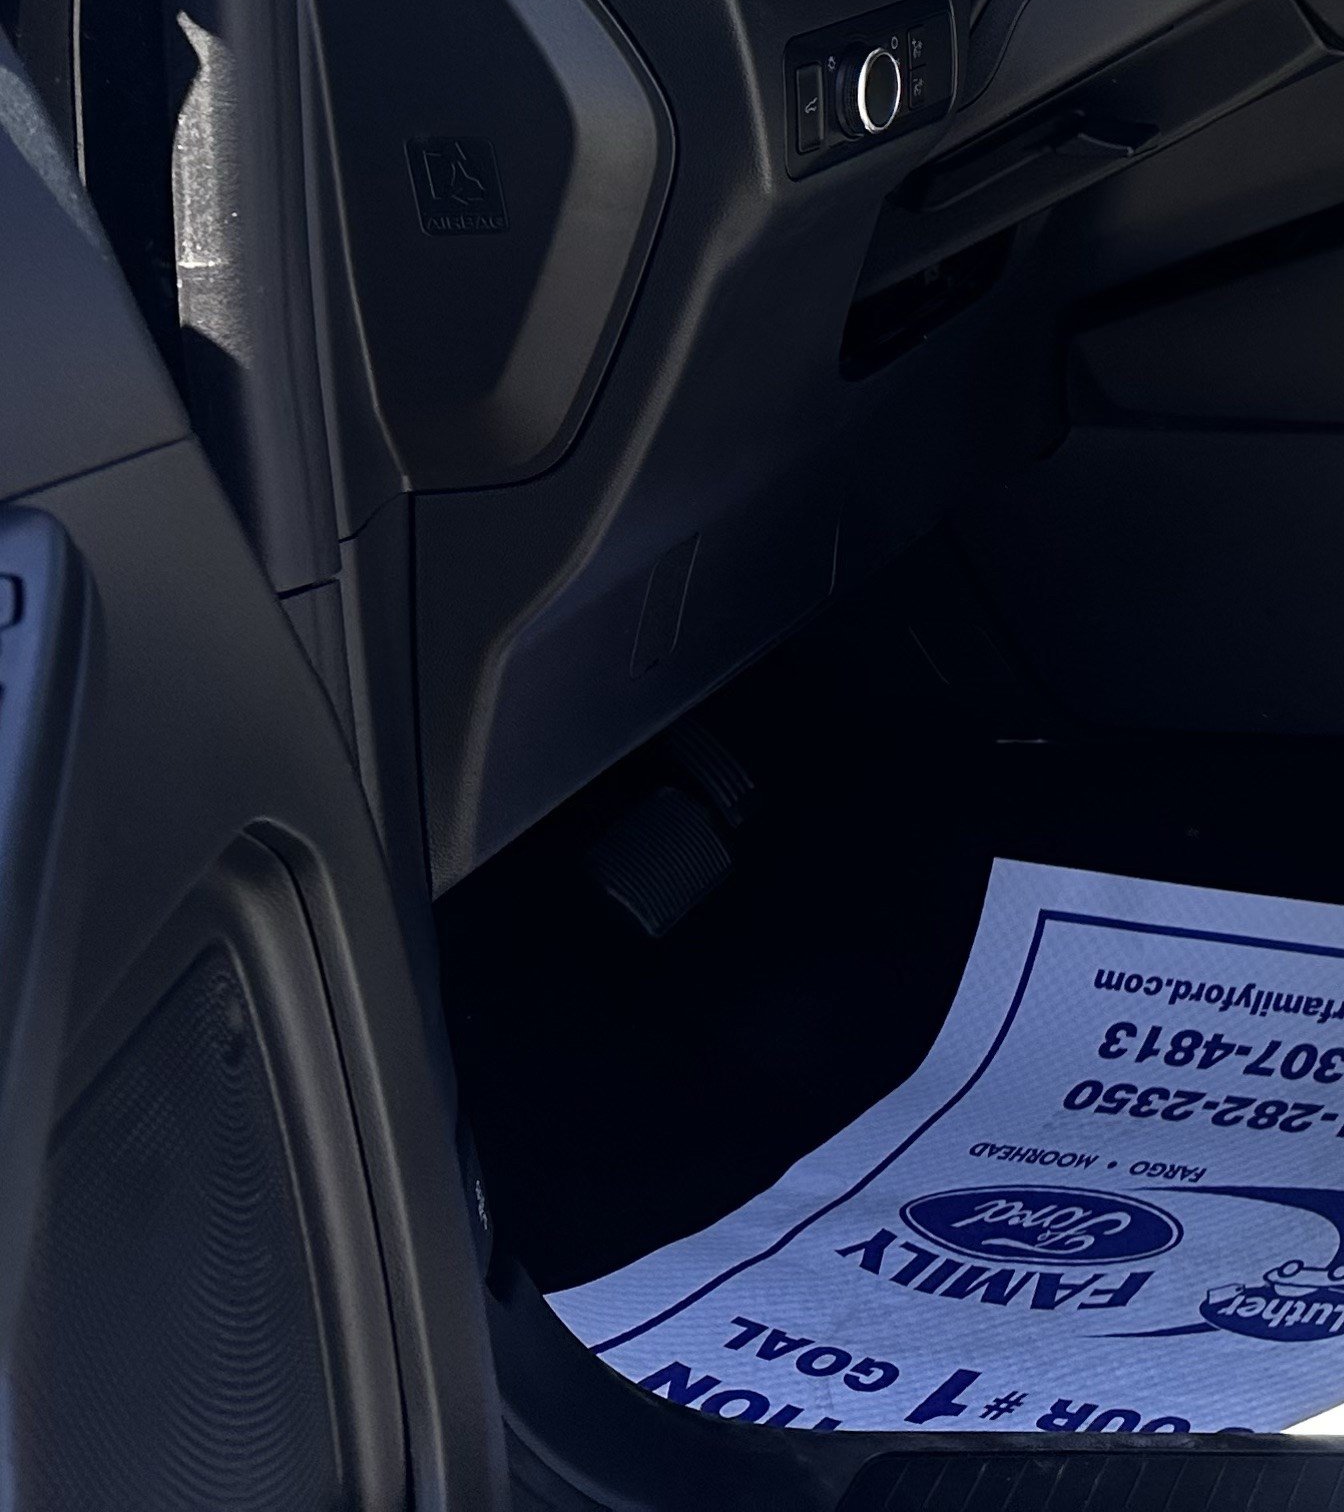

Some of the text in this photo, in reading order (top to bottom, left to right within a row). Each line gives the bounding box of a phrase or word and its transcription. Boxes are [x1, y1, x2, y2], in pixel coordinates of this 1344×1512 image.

[968, 1141, 1208, 1184] FARGO MOORHEAD
[951, 1198, 1132, 1255] Ford
[834, 1227, 1155, 1311] FAMILY
[722, 1316, 900, 1393] GOAL
[903, 1368, 1028, 1425] #1
